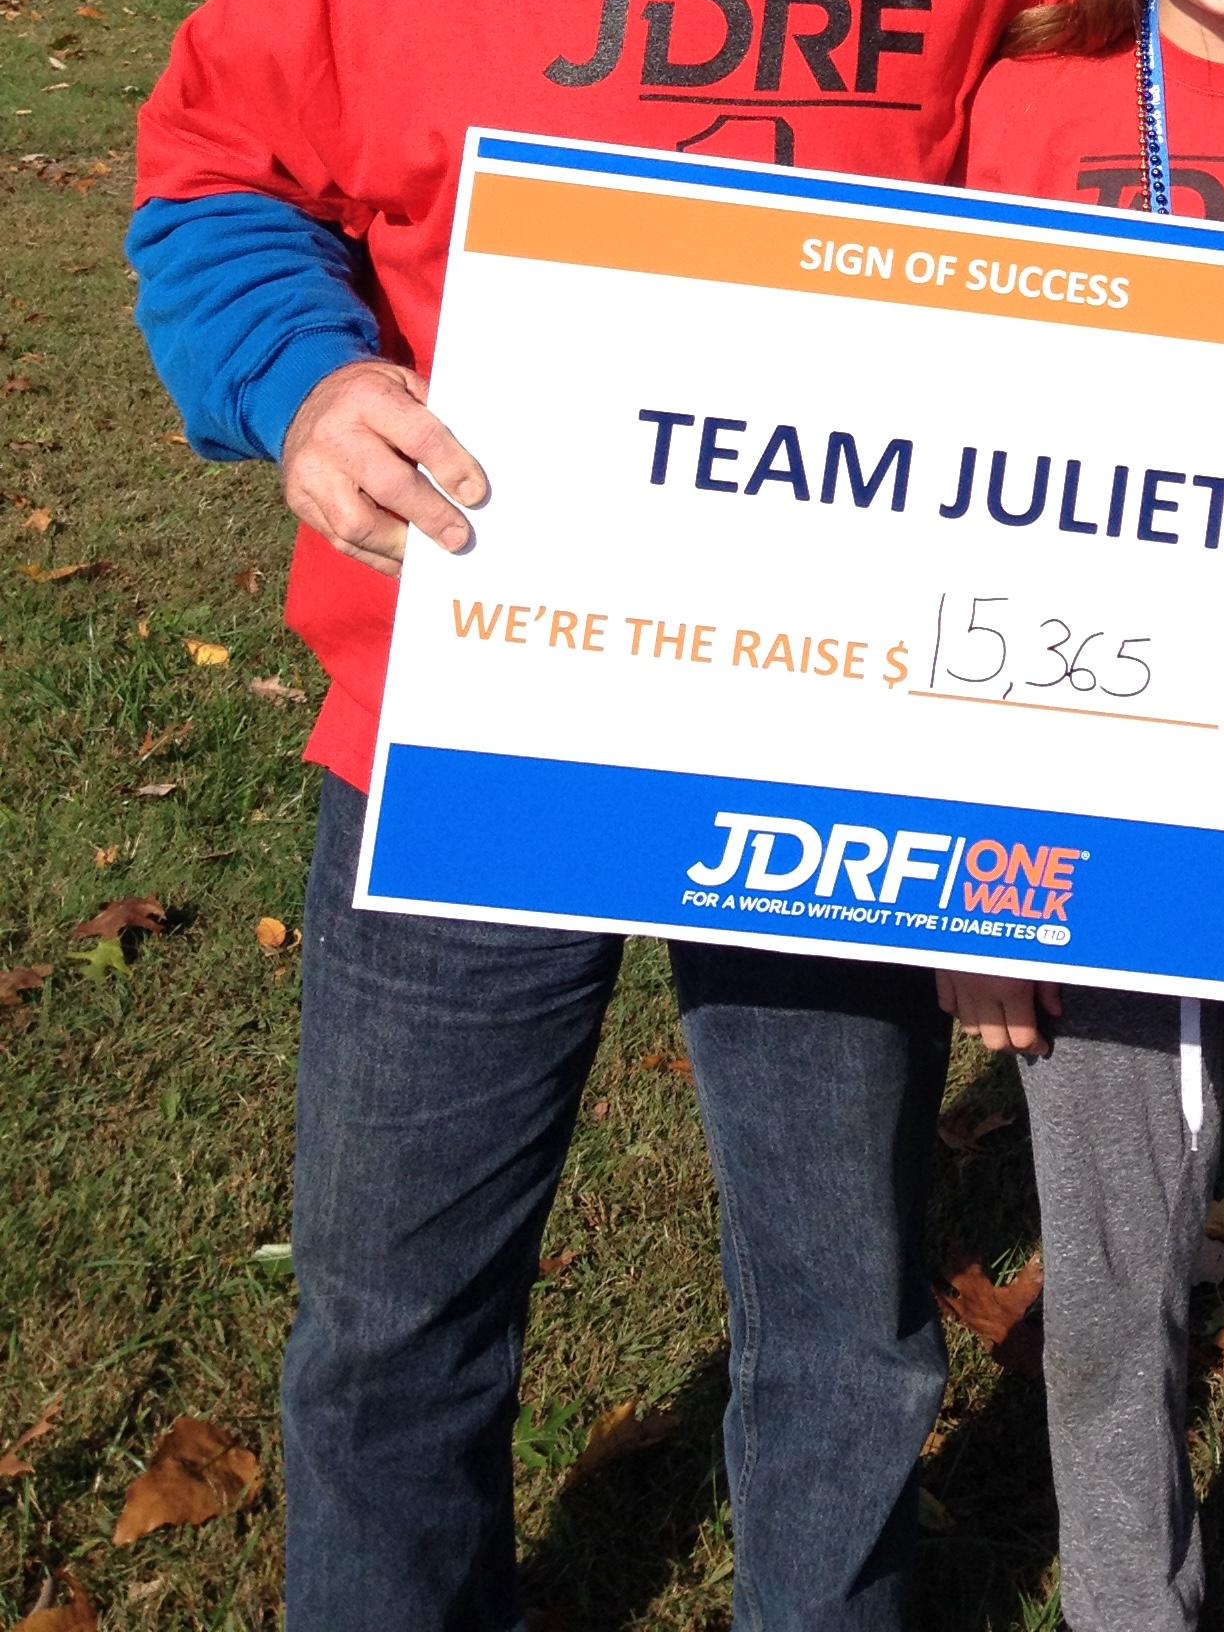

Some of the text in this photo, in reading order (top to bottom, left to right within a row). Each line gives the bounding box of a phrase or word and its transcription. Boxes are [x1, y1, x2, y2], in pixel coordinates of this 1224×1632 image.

[800, 238, 1130, 309] SIGN OF SUCCESS
[639, 409, 913, 512] TEAM
[452, 599, 608, 652] WE'RE
[625, 617, 717, 664] THE
[732, 629, 869, 680] RAISE
[687, 811, 951, 905] JDRF
[682, 889, 717, 909] FOR
[721, 894, 736, 909] A
[739, 895, 805, 916] WORLD
[808, 902, 889, 925] WITHOUT
[894, 911, 938, 930] TYPE
[940, 916, 948, 931] 1
[950, 917, 1036, 941] DIABETES
[963, 881, 1073, 922] WALK
